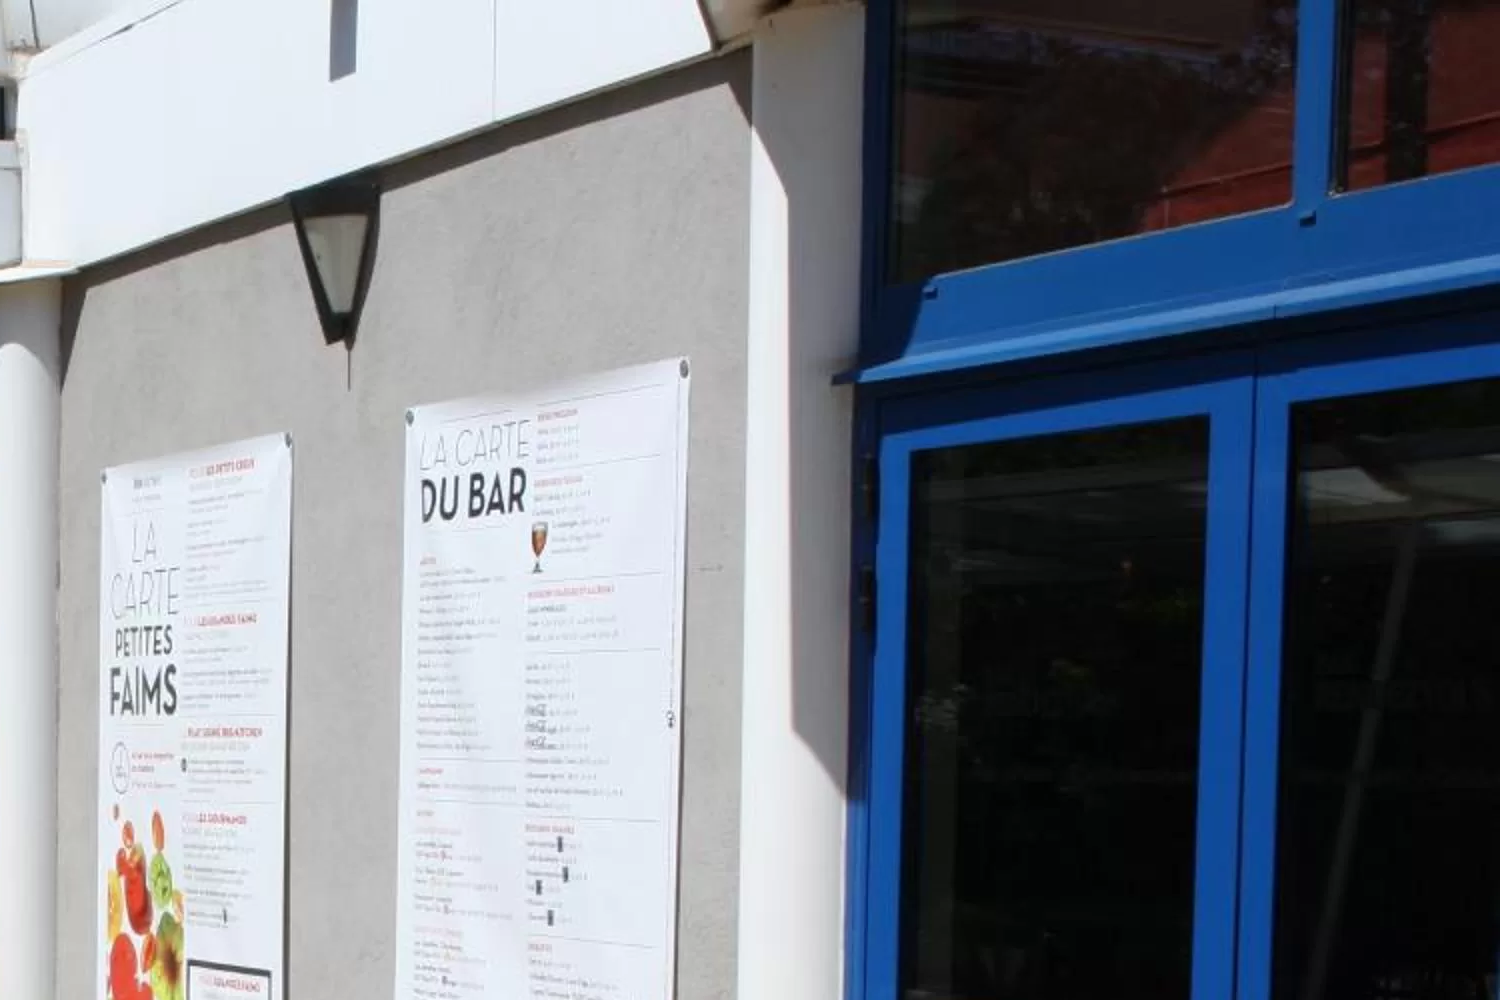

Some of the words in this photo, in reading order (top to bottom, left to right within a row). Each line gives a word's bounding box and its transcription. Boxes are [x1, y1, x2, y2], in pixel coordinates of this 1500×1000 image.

[419, 431, 447, 471] LA
[455, 419, 531, 467] CARTE
[420, 475, 460, 524] DU
[468, 467, 527, 518] BAR
[131, 519, 157, 563] LA
[111, 566, 181, 620] CARTE
[115, 624, 174, 658] PETITES
[110, 664, 178, 716] FAIMS
